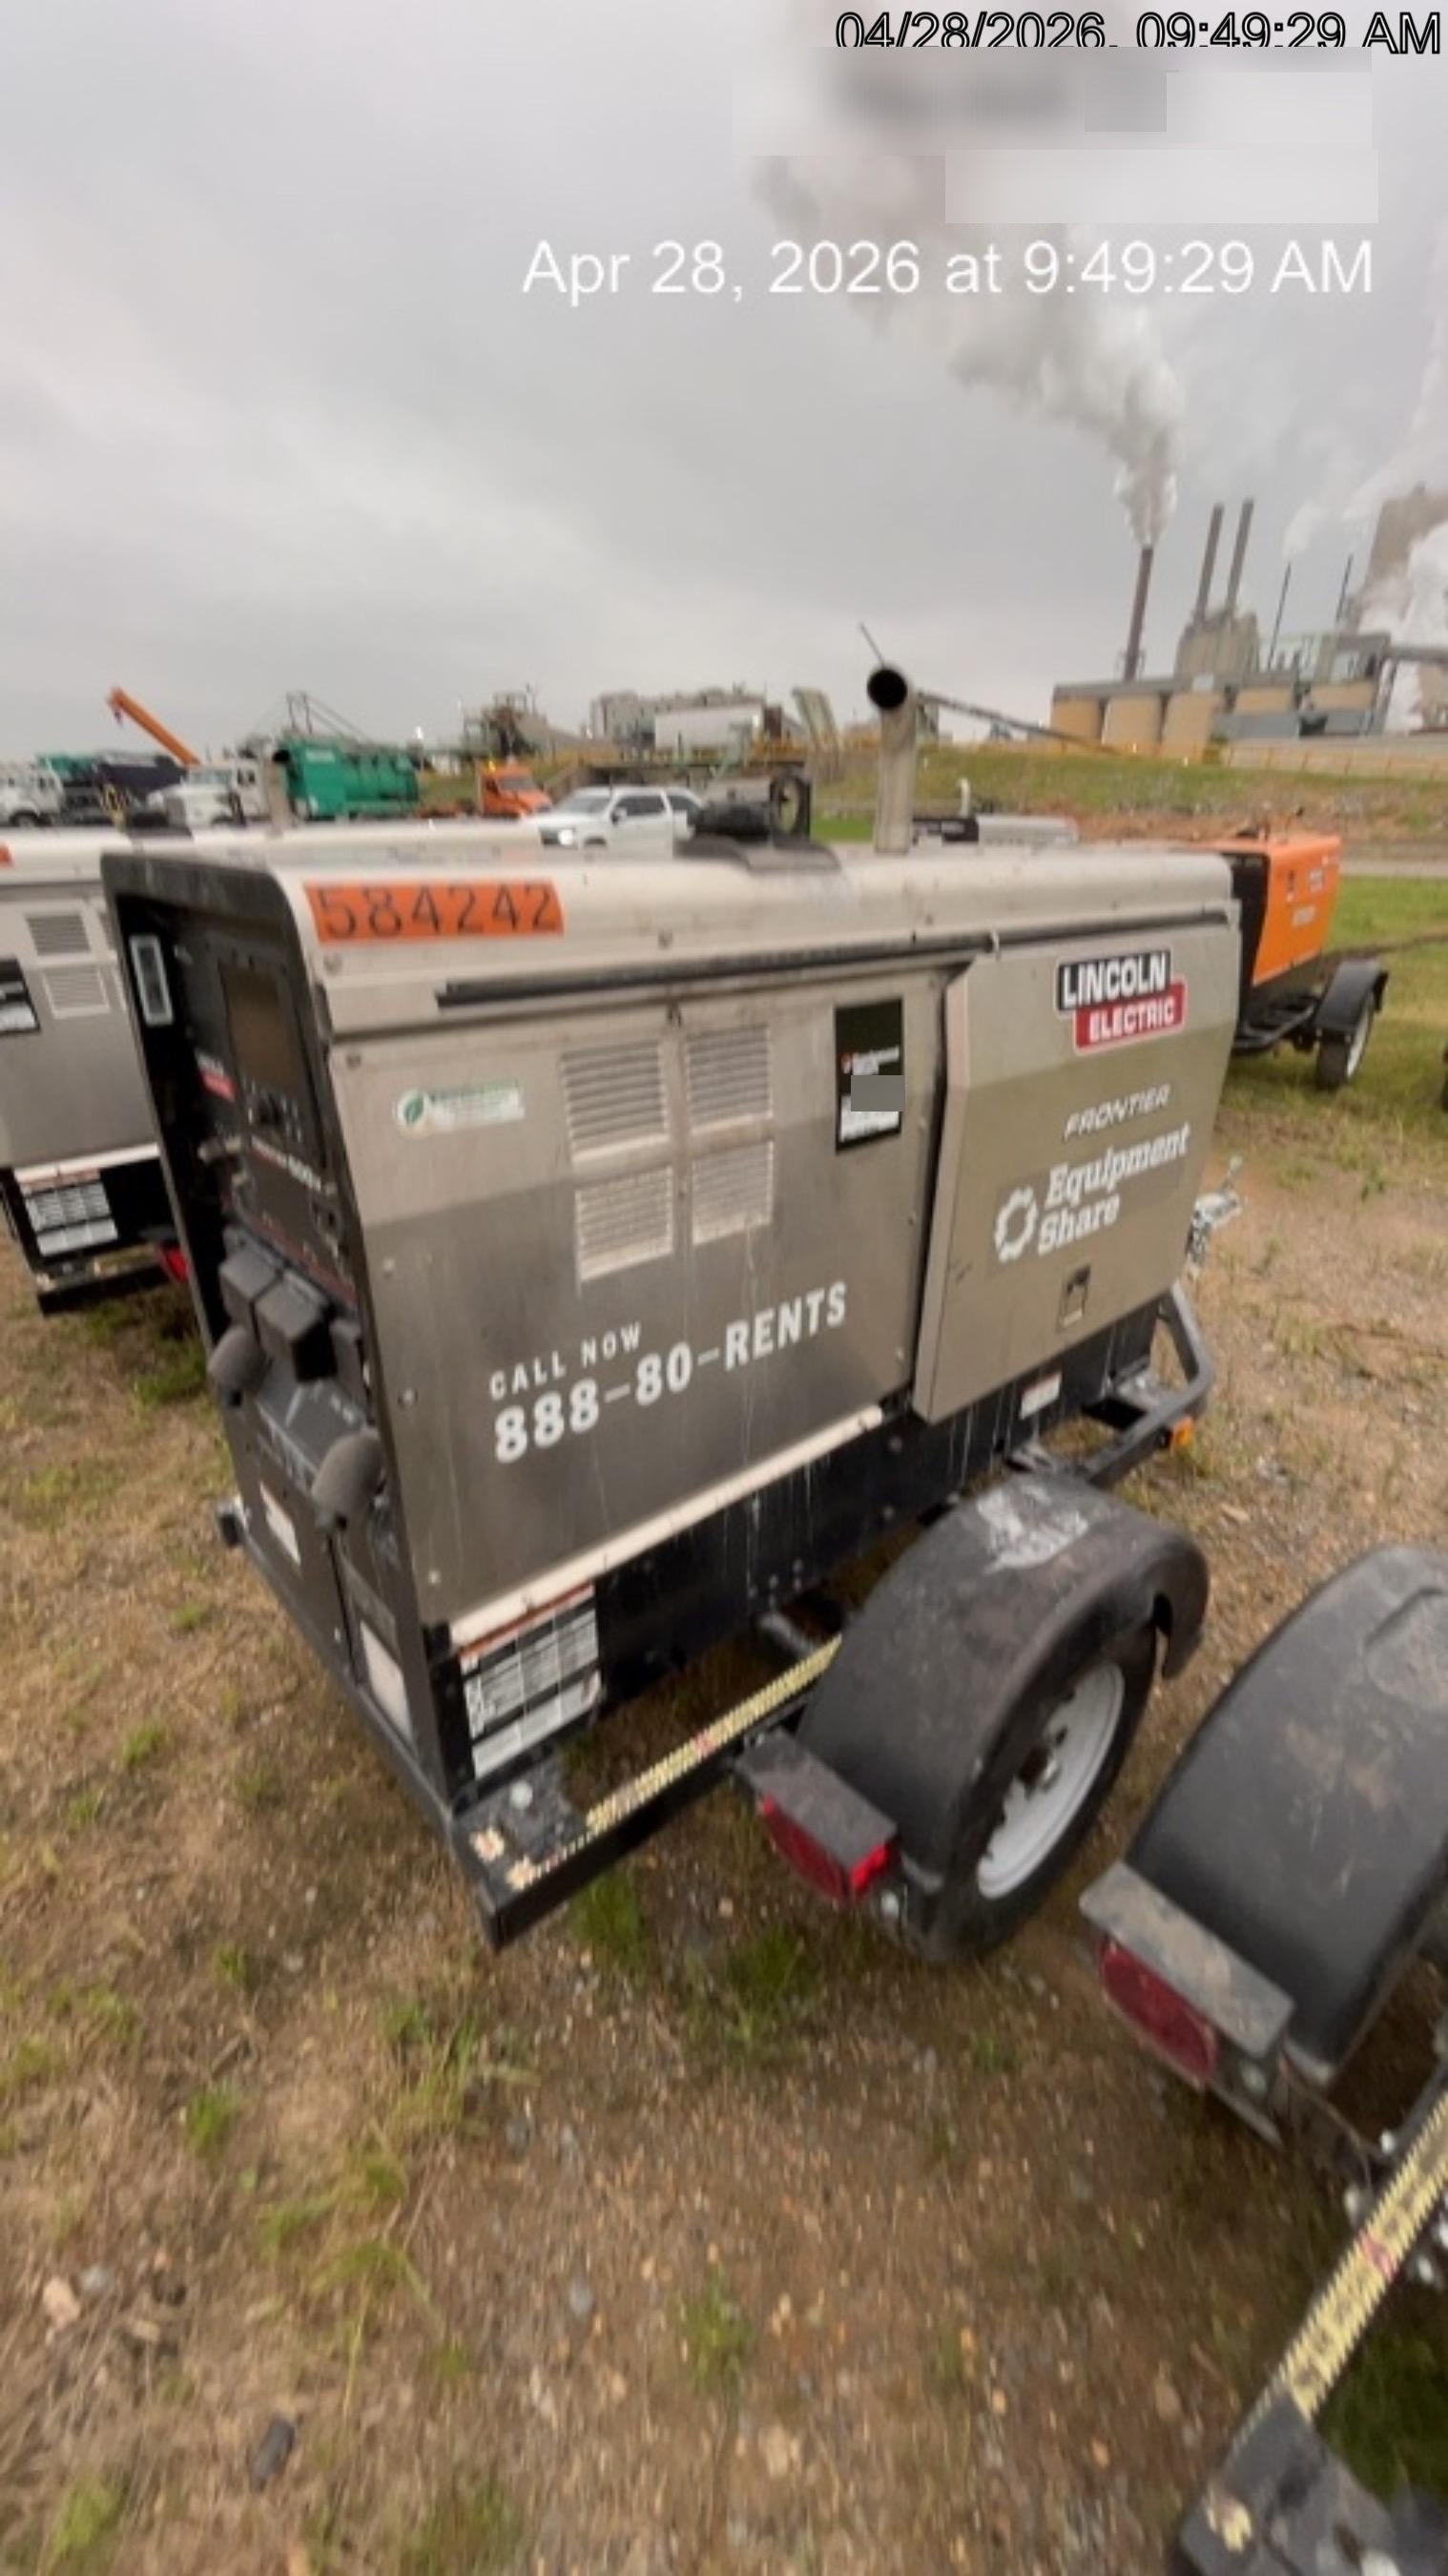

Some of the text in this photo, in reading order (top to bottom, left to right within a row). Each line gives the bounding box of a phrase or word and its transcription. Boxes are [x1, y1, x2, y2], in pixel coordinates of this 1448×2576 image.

[318, 883, 561, 938] 584242
[1063, 952, 1167, 1008] LINCOLN
[1088, 996, 1174, 1043] ELECTRIC
[1063, 1084, 1170, 1141] FRONTIER
[1045, 1123, 1190, 1209] Equipment
[1038, 1194, 1120, 1257] Share
[489, 1322, 641, 1400] CALL NOW
[494, 1281, 848, 1464] 888-80-RENTS
